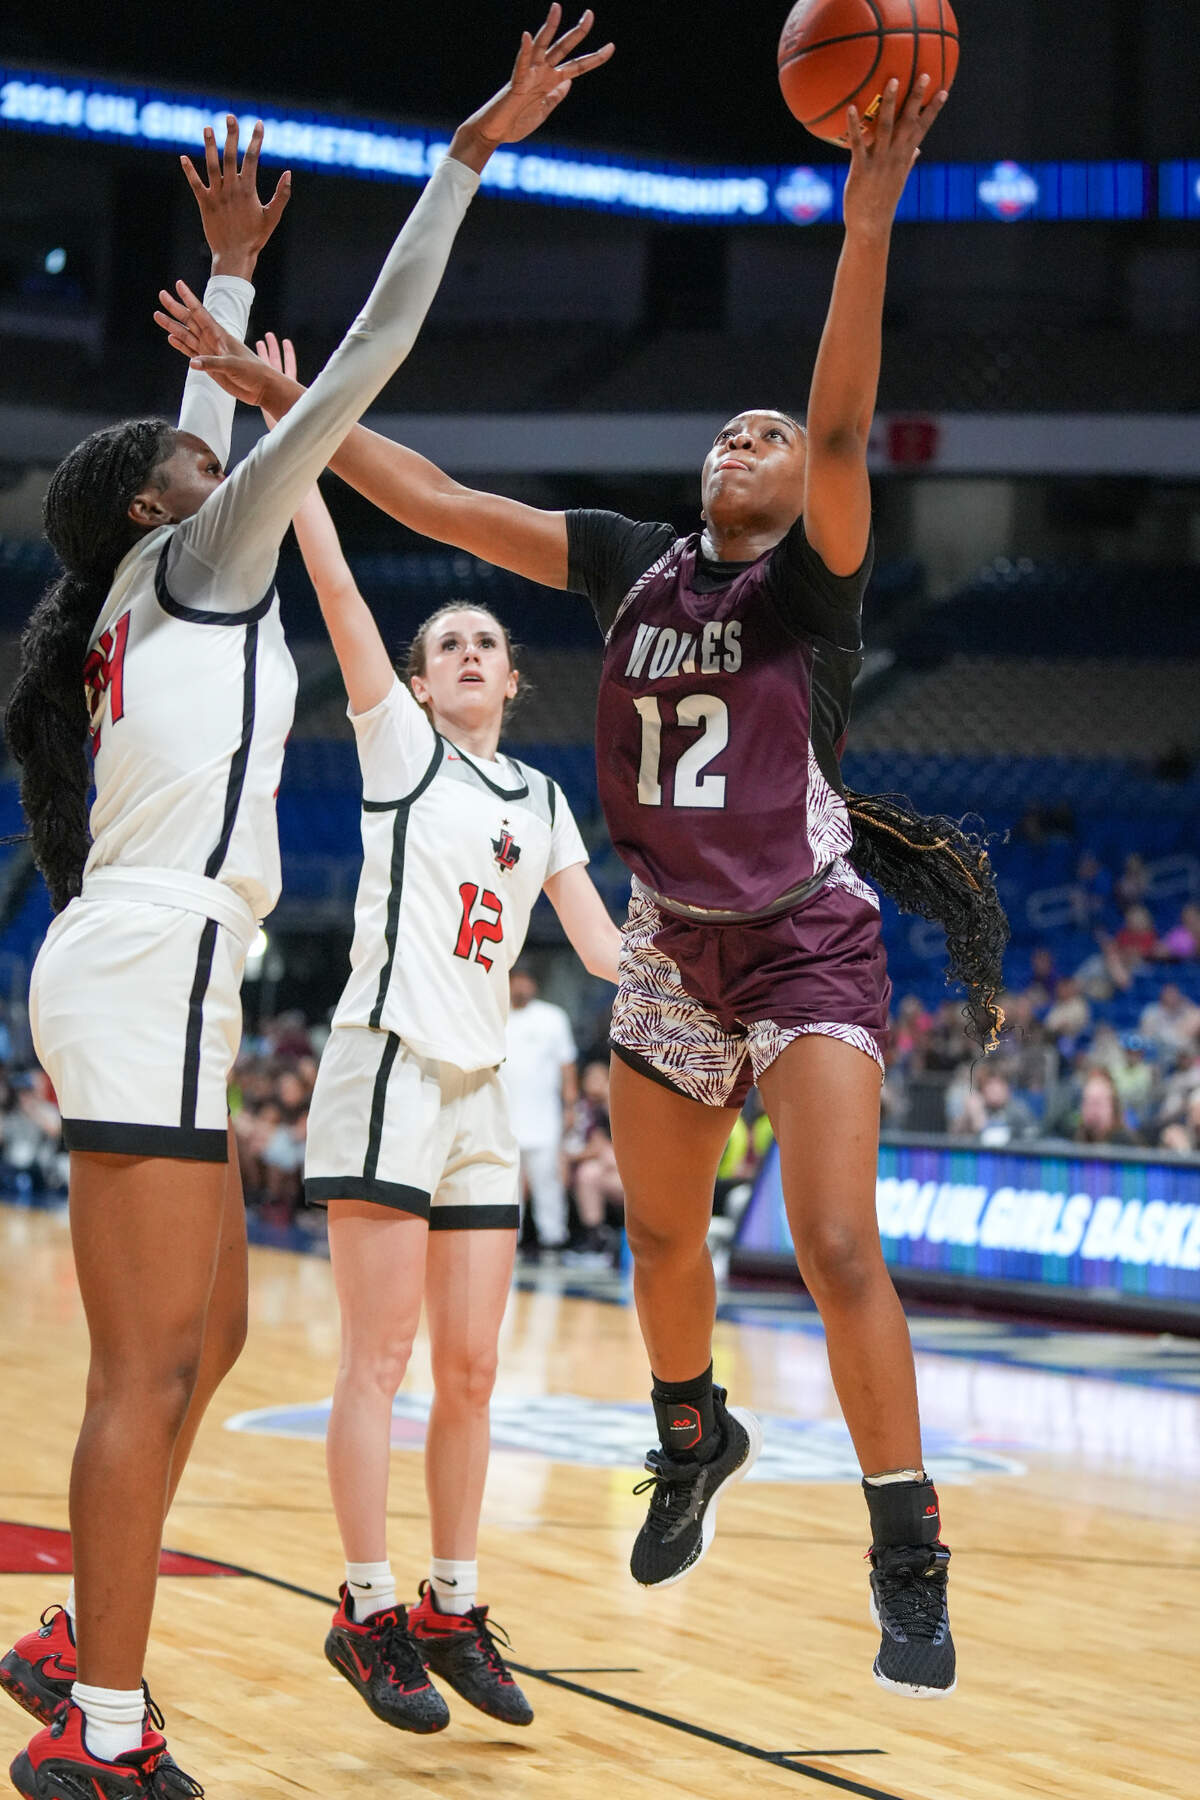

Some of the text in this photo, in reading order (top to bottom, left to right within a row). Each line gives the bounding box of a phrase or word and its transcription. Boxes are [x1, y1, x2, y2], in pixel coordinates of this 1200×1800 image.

[86, 93, 139, 136] UIL
[518, 154, 769, 215] CHAMPIONSHIPS
[632, 693, 729, 808] 12
[453, 881, 504, 974] 12
[979, 1186, 1093, 1258] GIRLS
